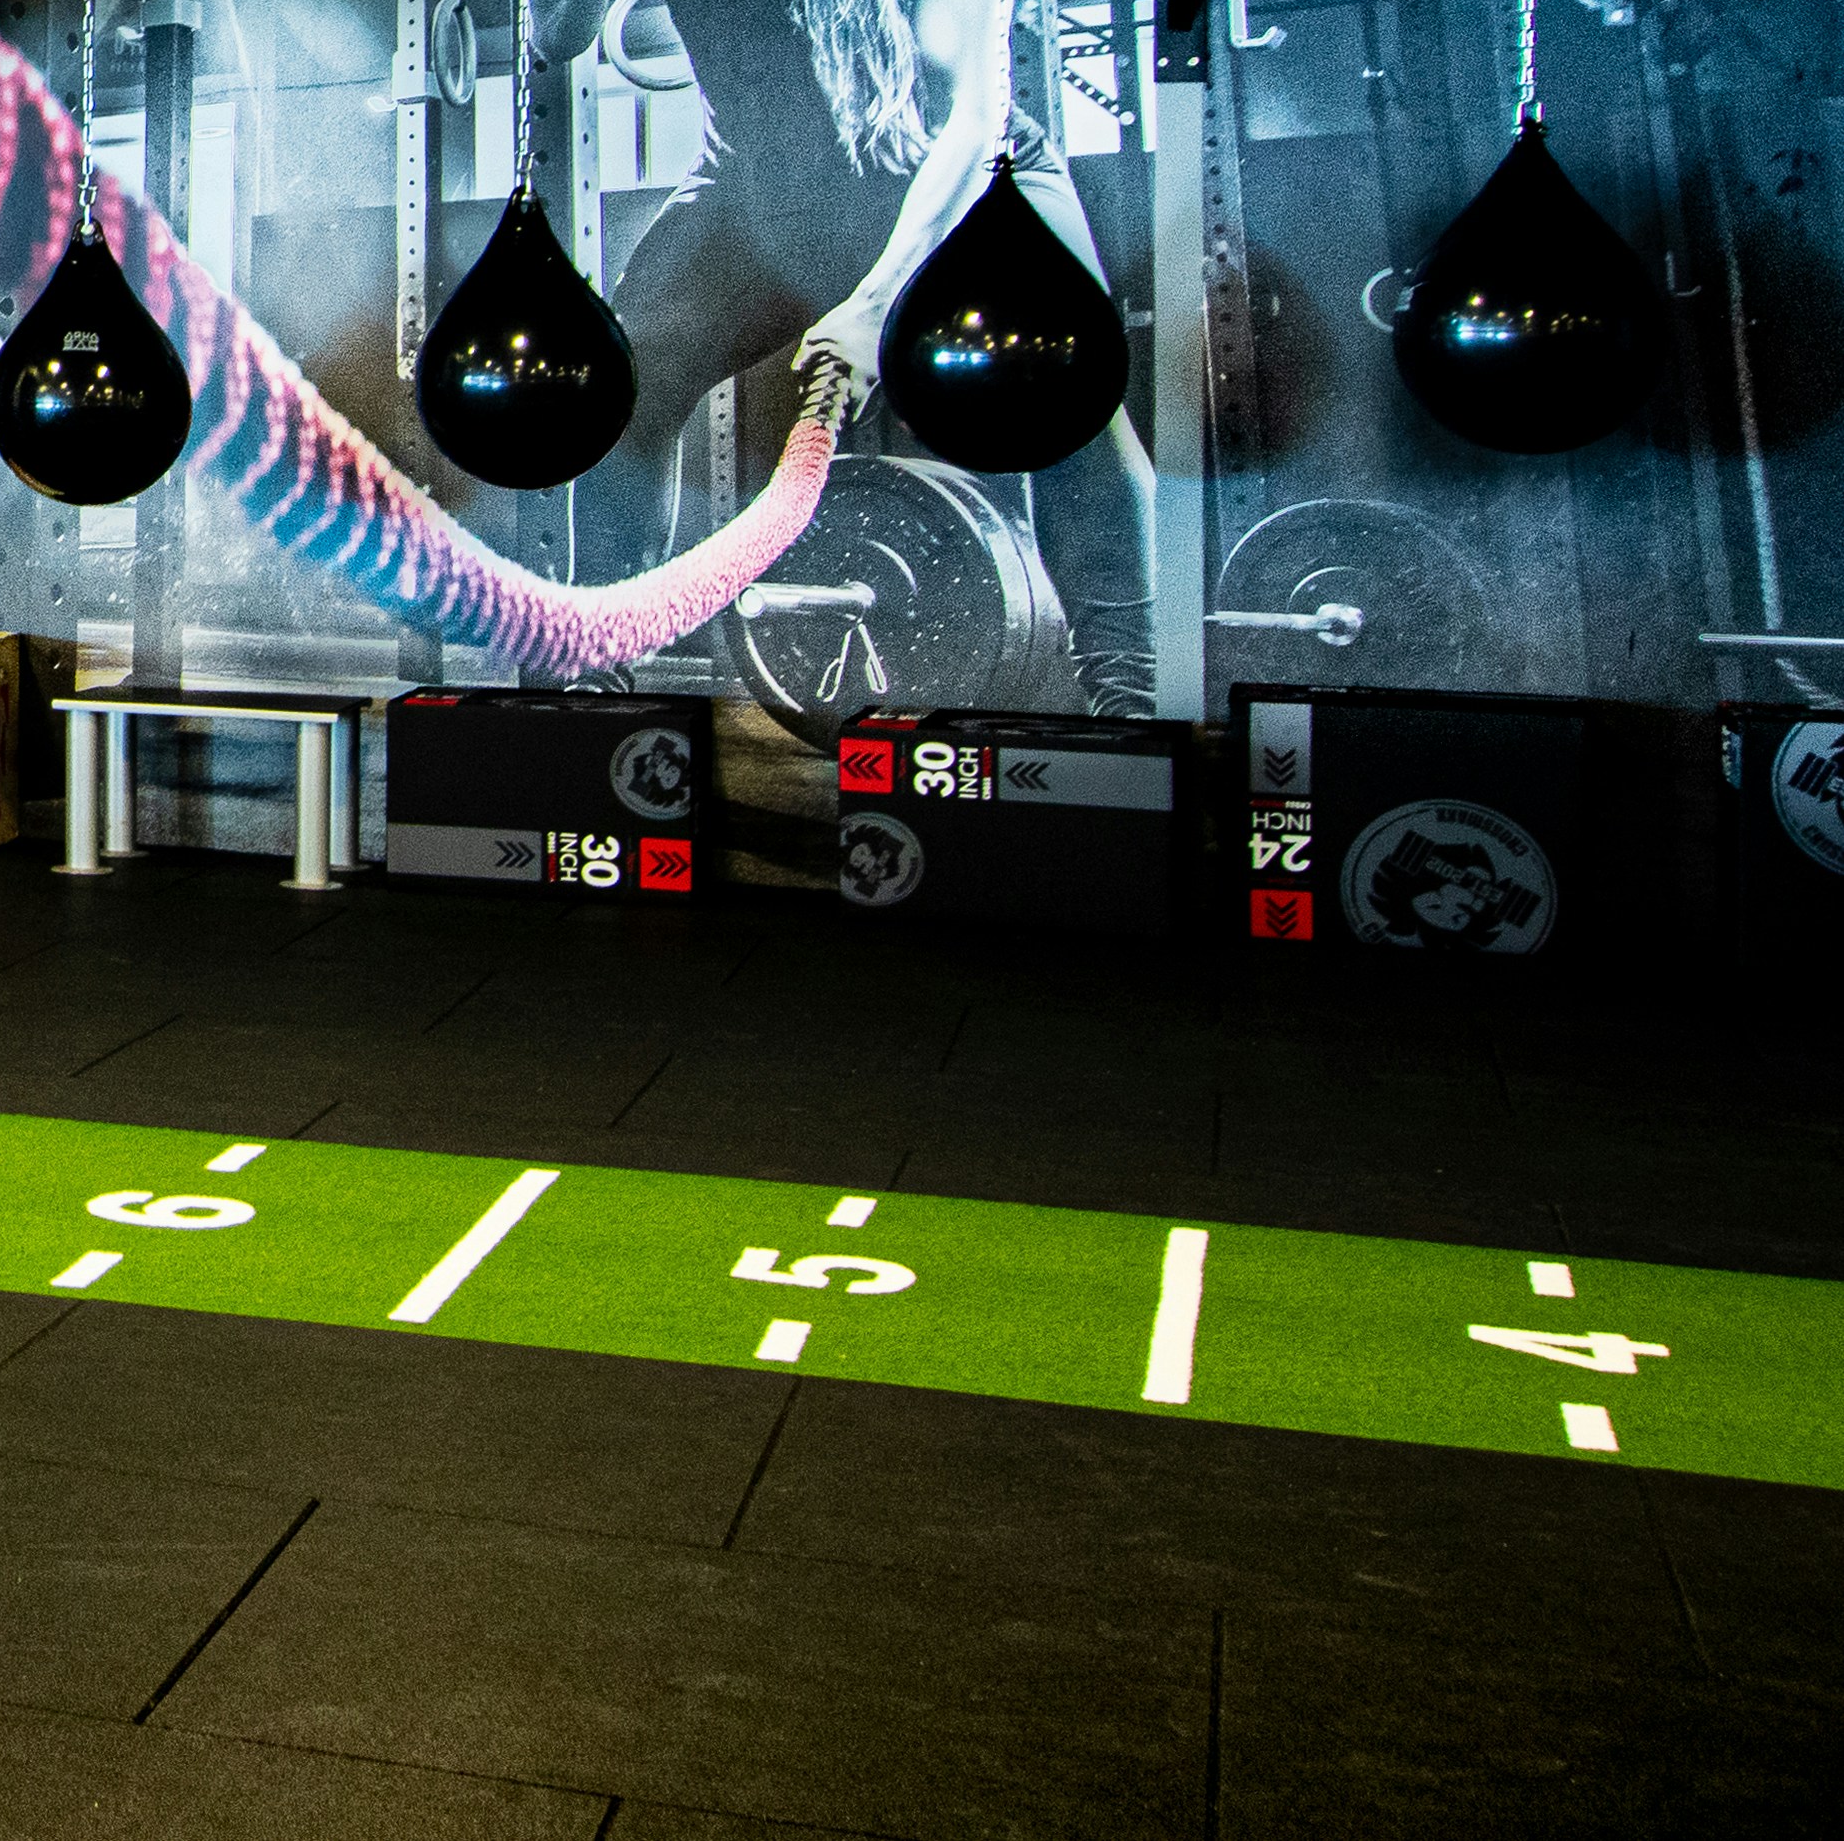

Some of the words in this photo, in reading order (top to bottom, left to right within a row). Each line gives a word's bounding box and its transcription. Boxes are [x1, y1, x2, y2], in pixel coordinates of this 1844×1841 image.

[913, 741, 956, 798] 30
[958, 747, 979, 799] INCH
[1252, 811, 1312, 832] INCH
[559, 831, 579, 882] INCH
[580, 833, 621, 888] 30
[1248, 832, 1312, 873] 24
[87, 1190, 257, 1231] 6
[730, 1247, 917, 1296] 5
[1468, 1324, 1670, 1374] 4
